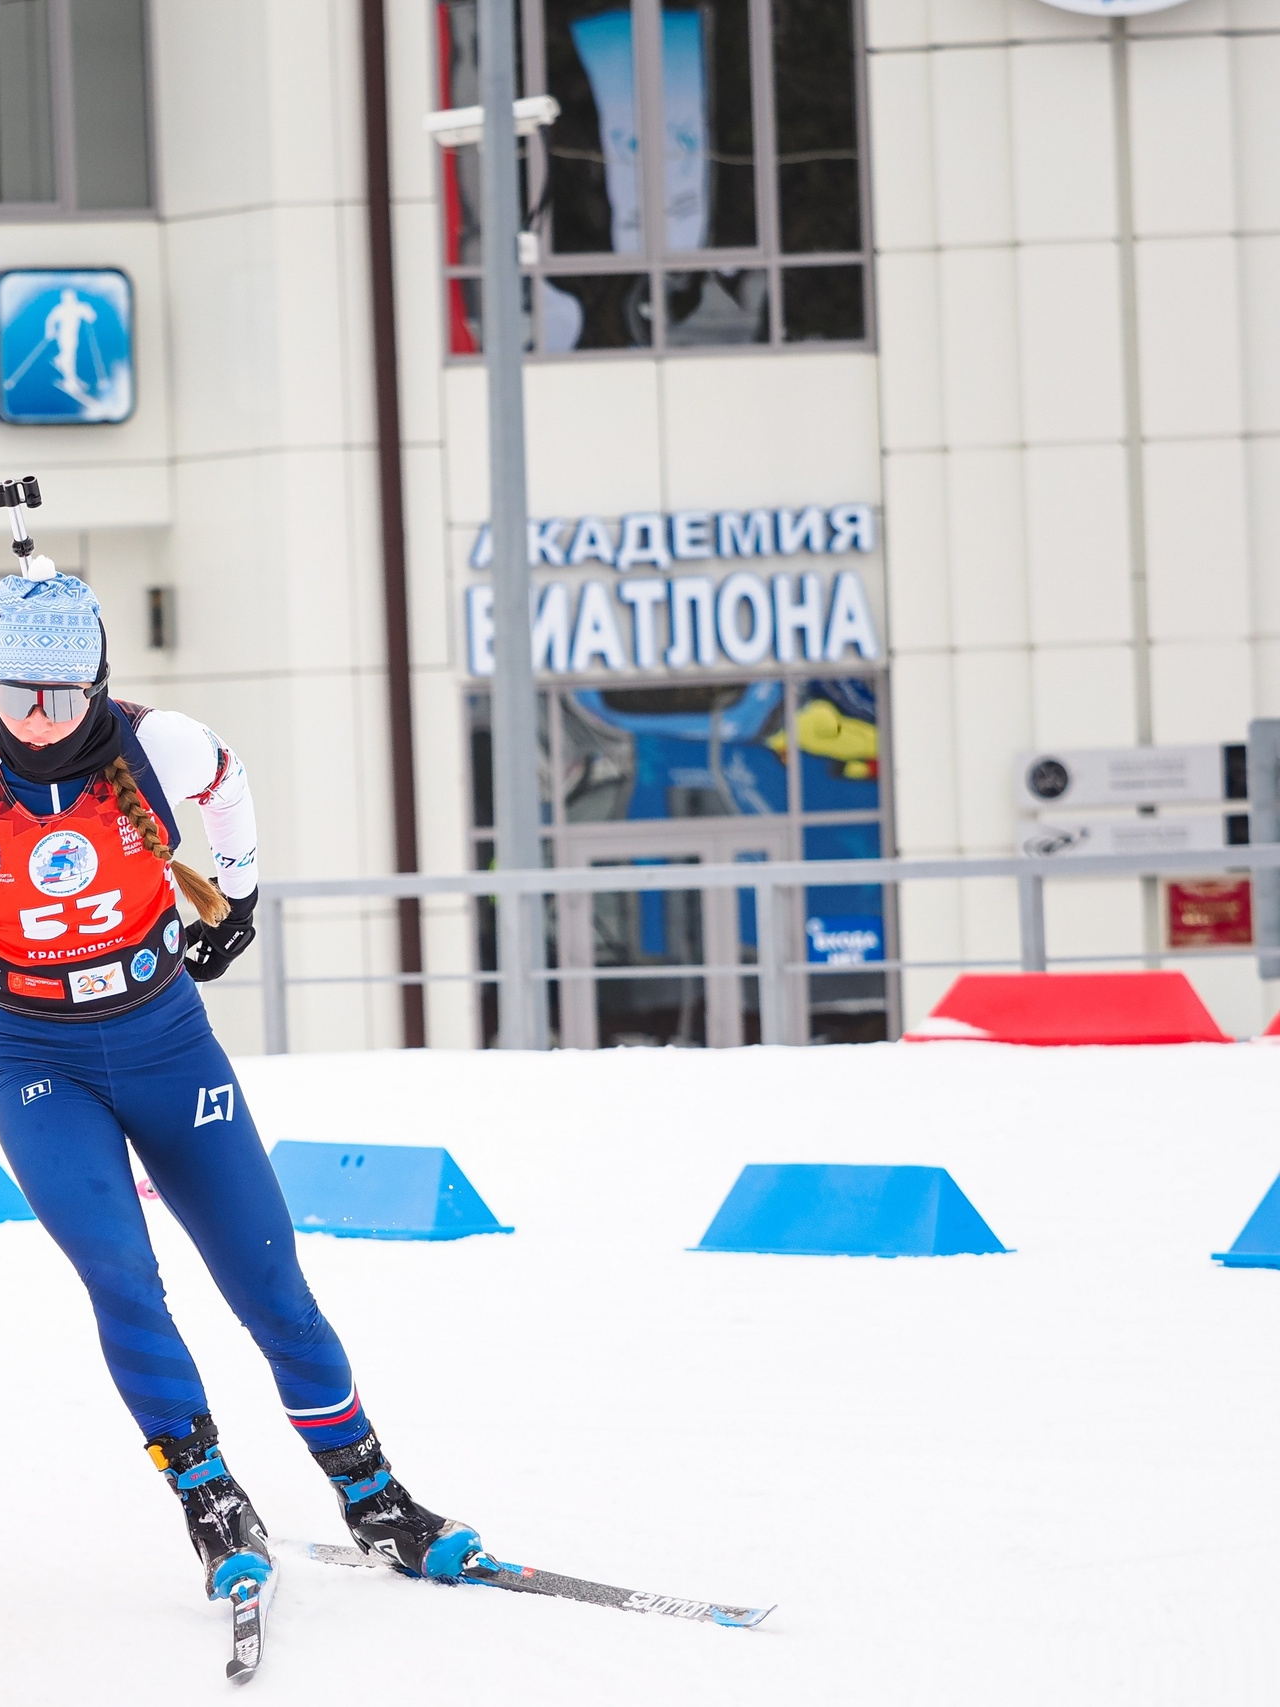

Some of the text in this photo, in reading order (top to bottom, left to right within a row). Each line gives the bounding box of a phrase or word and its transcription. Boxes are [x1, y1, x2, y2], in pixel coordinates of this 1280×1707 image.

[32, 832, 88, 857] ПЕРВЕНСТВО РОССИИ
[19, 889, 123, 940] 53
